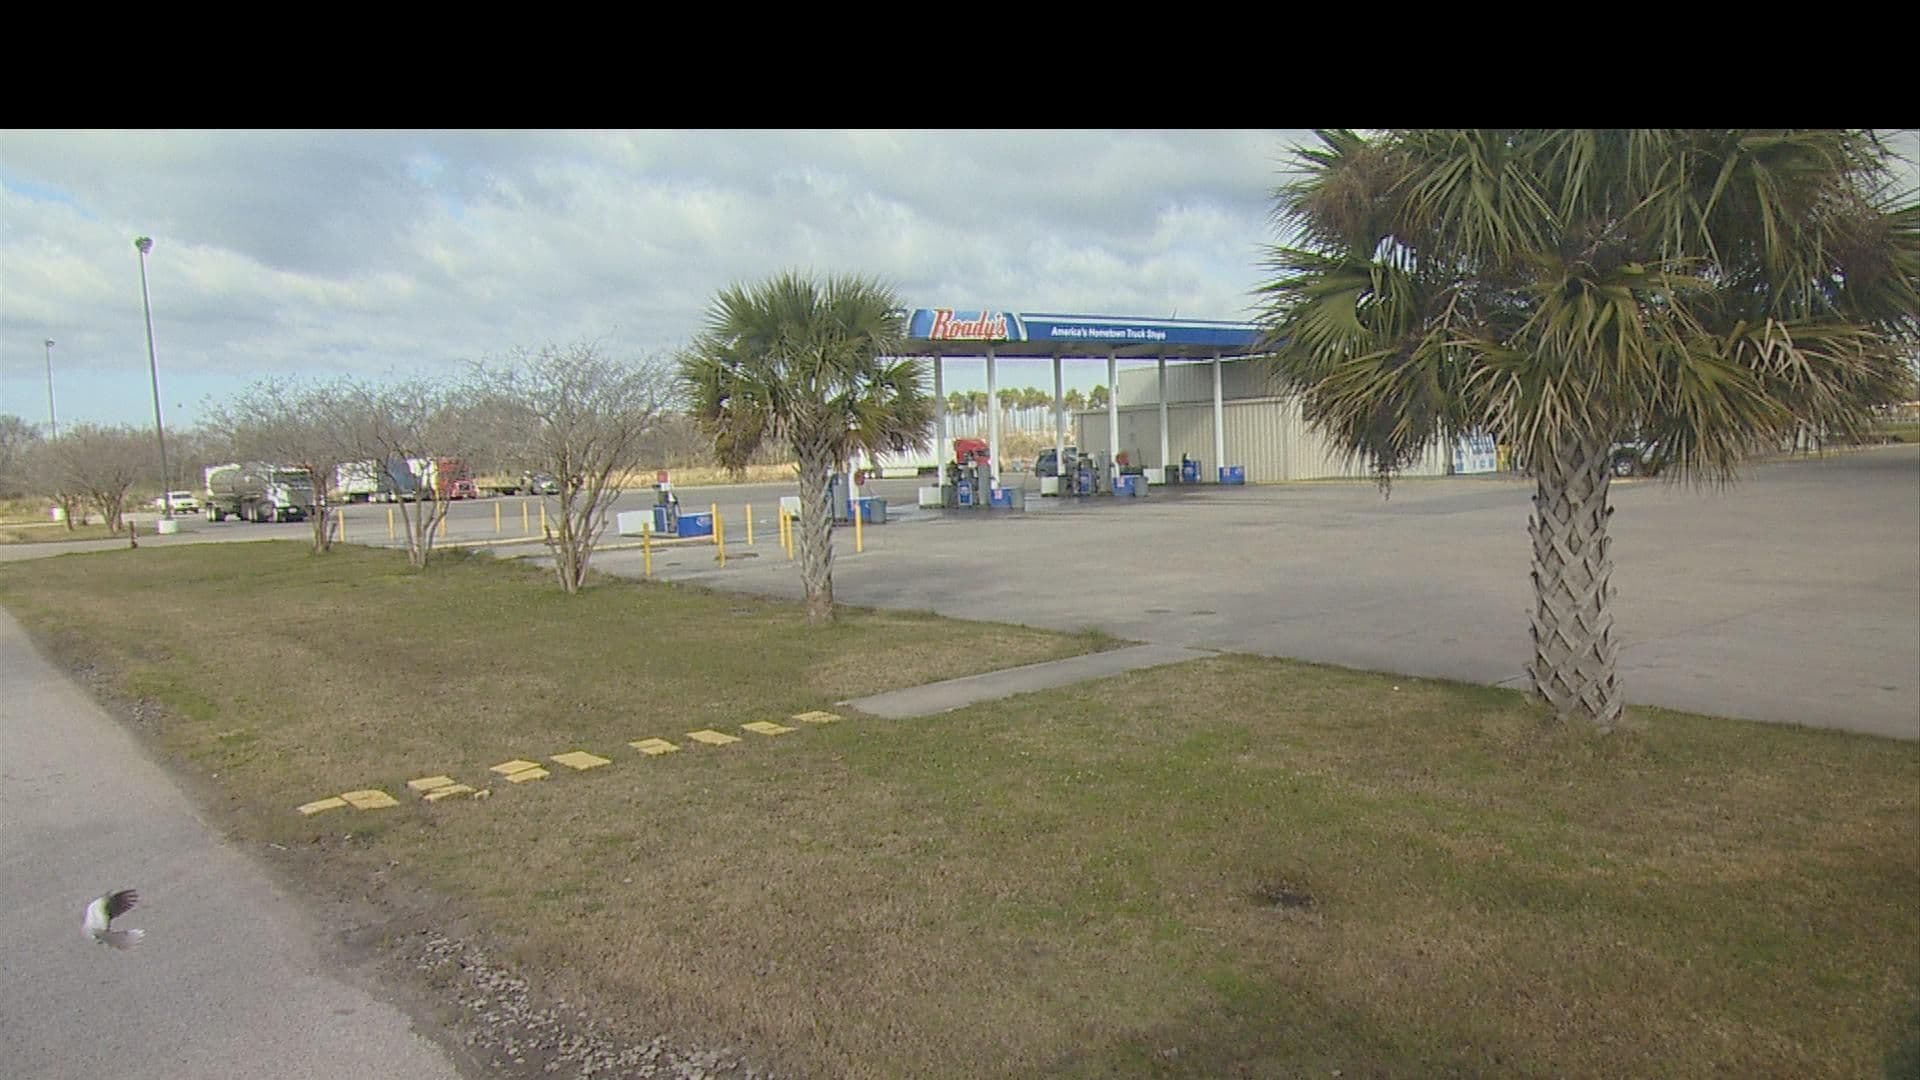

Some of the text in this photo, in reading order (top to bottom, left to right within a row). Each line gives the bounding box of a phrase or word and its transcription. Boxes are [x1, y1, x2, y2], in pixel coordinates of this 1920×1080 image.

[930, 307, 1007, 340] Roady's
[1051, 326, 1087, 337] America's
[1088, 328, 1126, 338] Hometown
[1126, 328, 1146, 339] Truck
